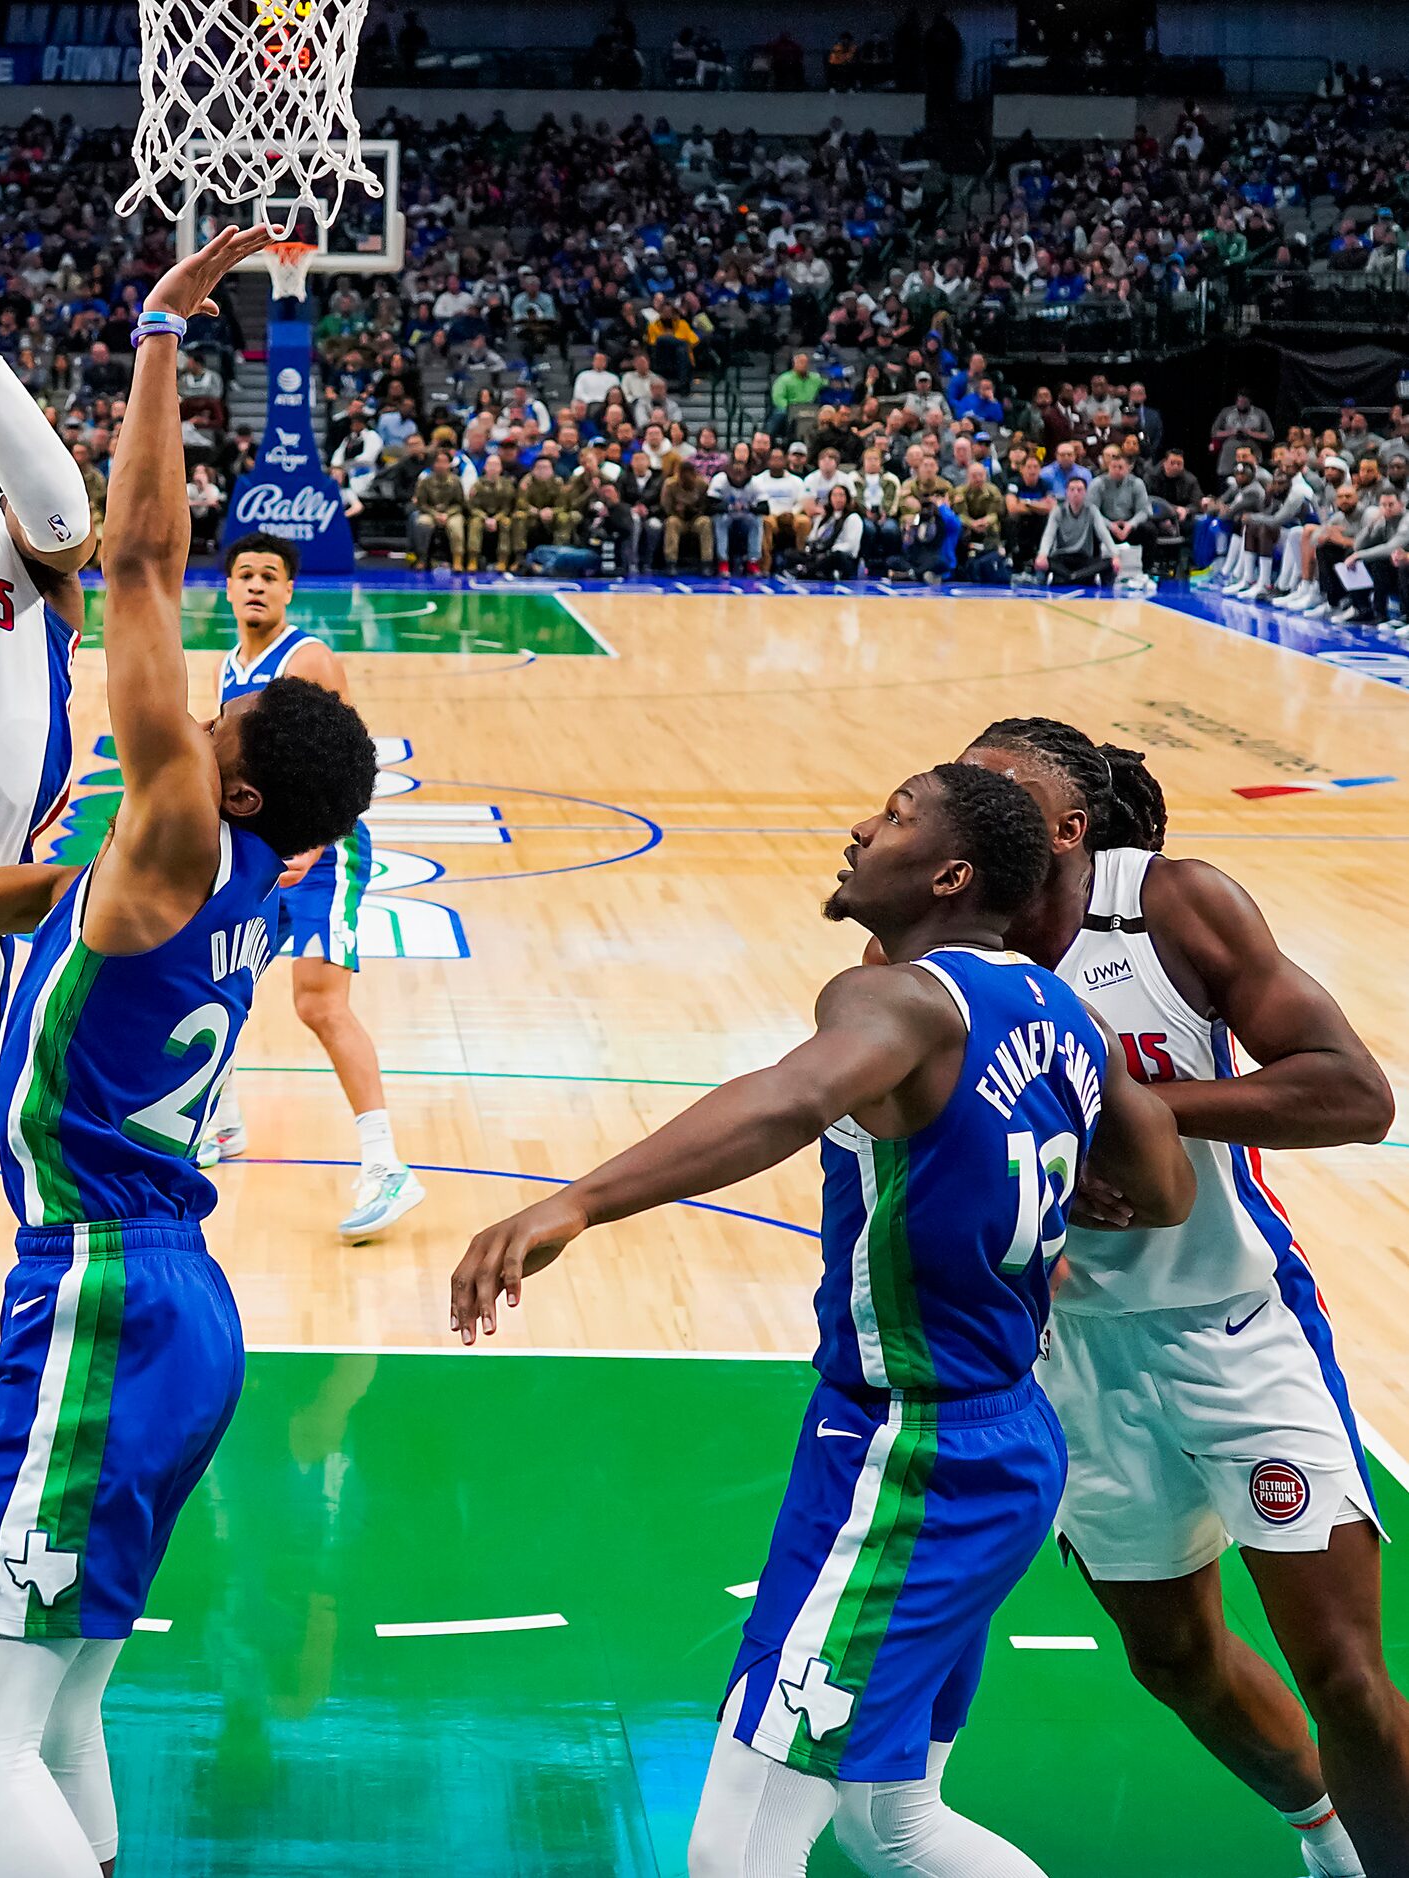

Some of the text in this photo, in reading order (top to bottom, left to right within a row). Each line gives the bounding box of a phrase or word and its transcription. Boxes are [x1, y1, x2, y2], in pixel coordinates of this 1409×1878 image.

[236, 484, 339, 533] Bally
[1084, 958, 1132, 985] UWM
[120, 1003, 234, 1164] 2
[1259, 1480, 1296, 1492] DETROIT
[1259, 1491, 1298, 1503] PISTONS
